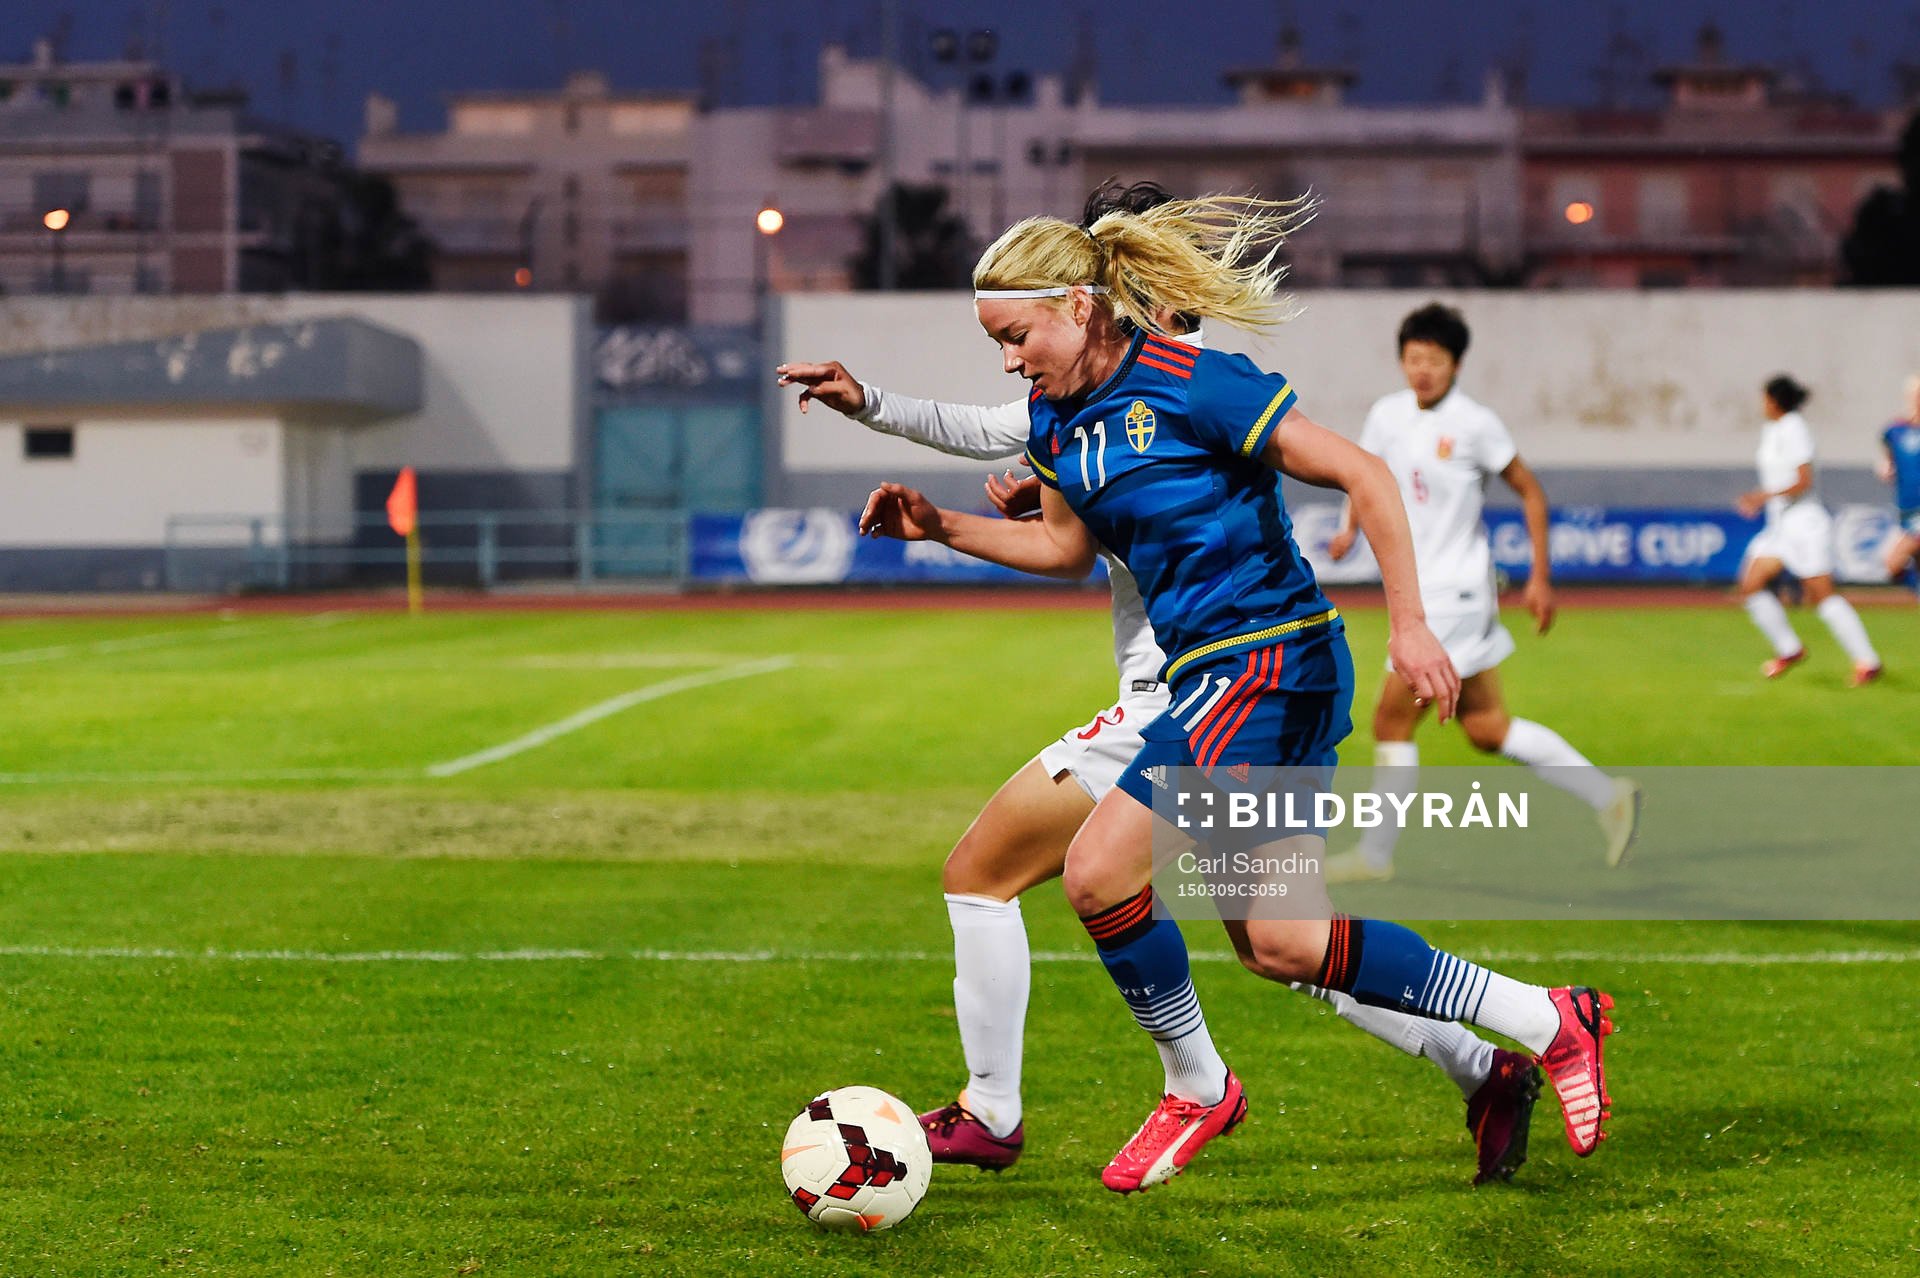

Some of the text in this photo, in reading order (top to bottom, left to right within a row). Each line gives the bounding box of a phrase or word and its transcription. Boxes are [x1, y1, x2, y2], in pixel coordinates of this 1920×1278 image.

[1073, 420, 1107, 491] 11
[1638, 521, 1727, 567] CUP
[1170, 673, 1232, 732] 11
